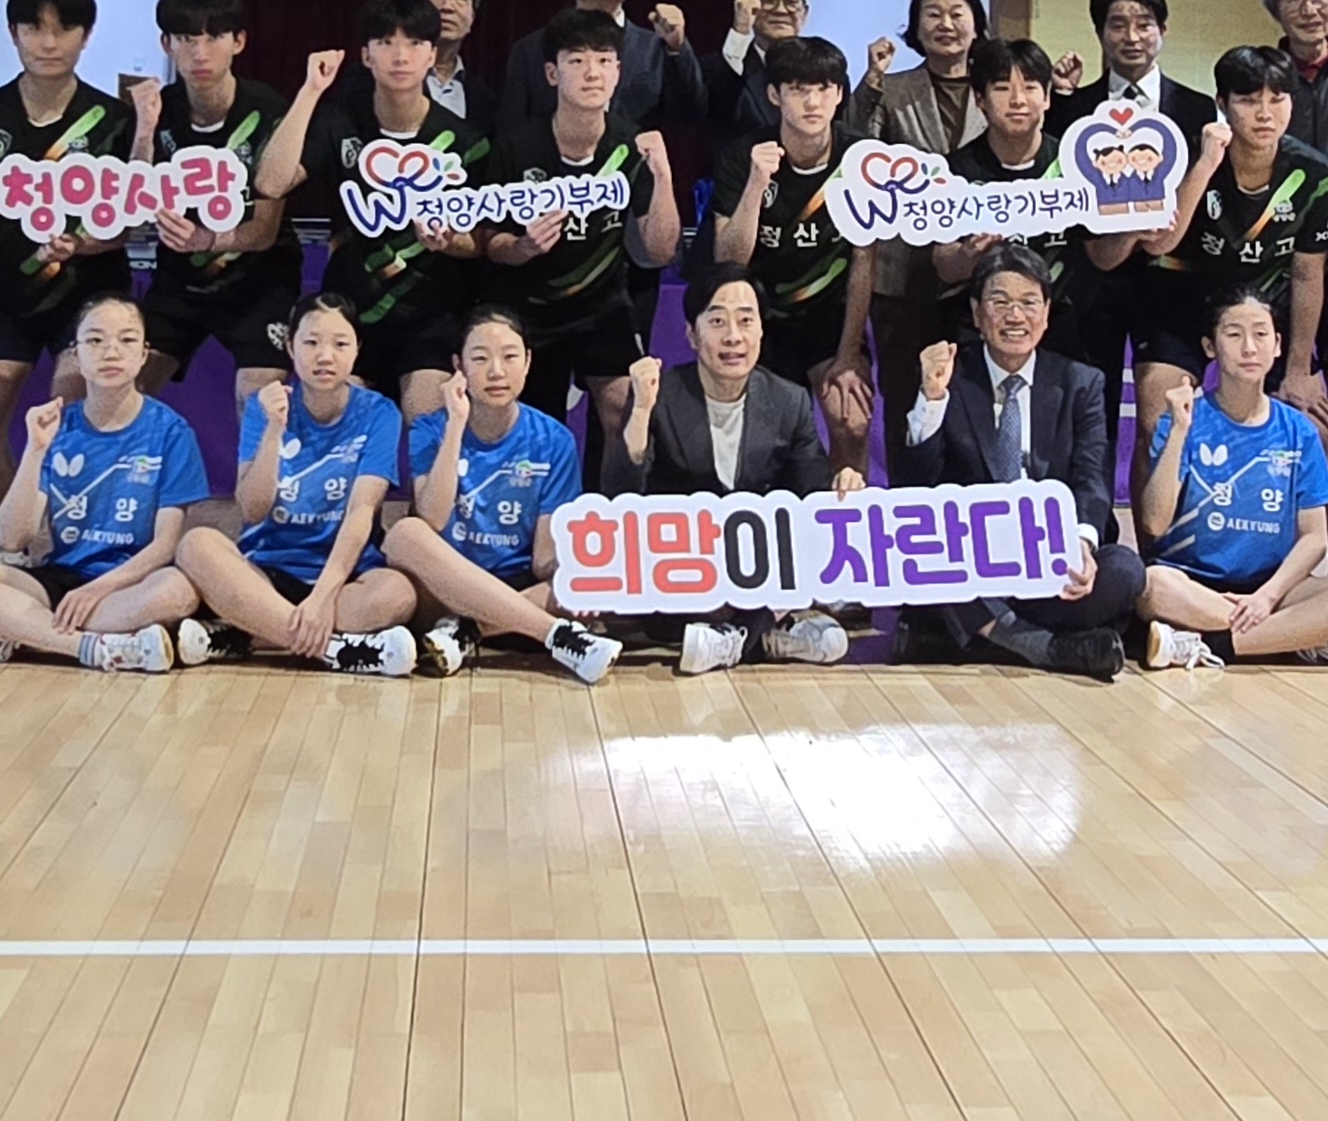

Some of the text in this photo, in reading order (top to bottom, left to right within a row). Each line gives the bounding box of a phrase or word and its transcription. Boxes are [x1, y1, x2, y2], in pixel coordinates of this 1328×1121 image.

[2, 157, 236, 232] 청양사랑
[416, 178, 625, 228] 청양사랑기부제
[903, 187, 1090, 231] 청양사랑기부제
[566, 495, 1069, 595] 희망이 자란다!
